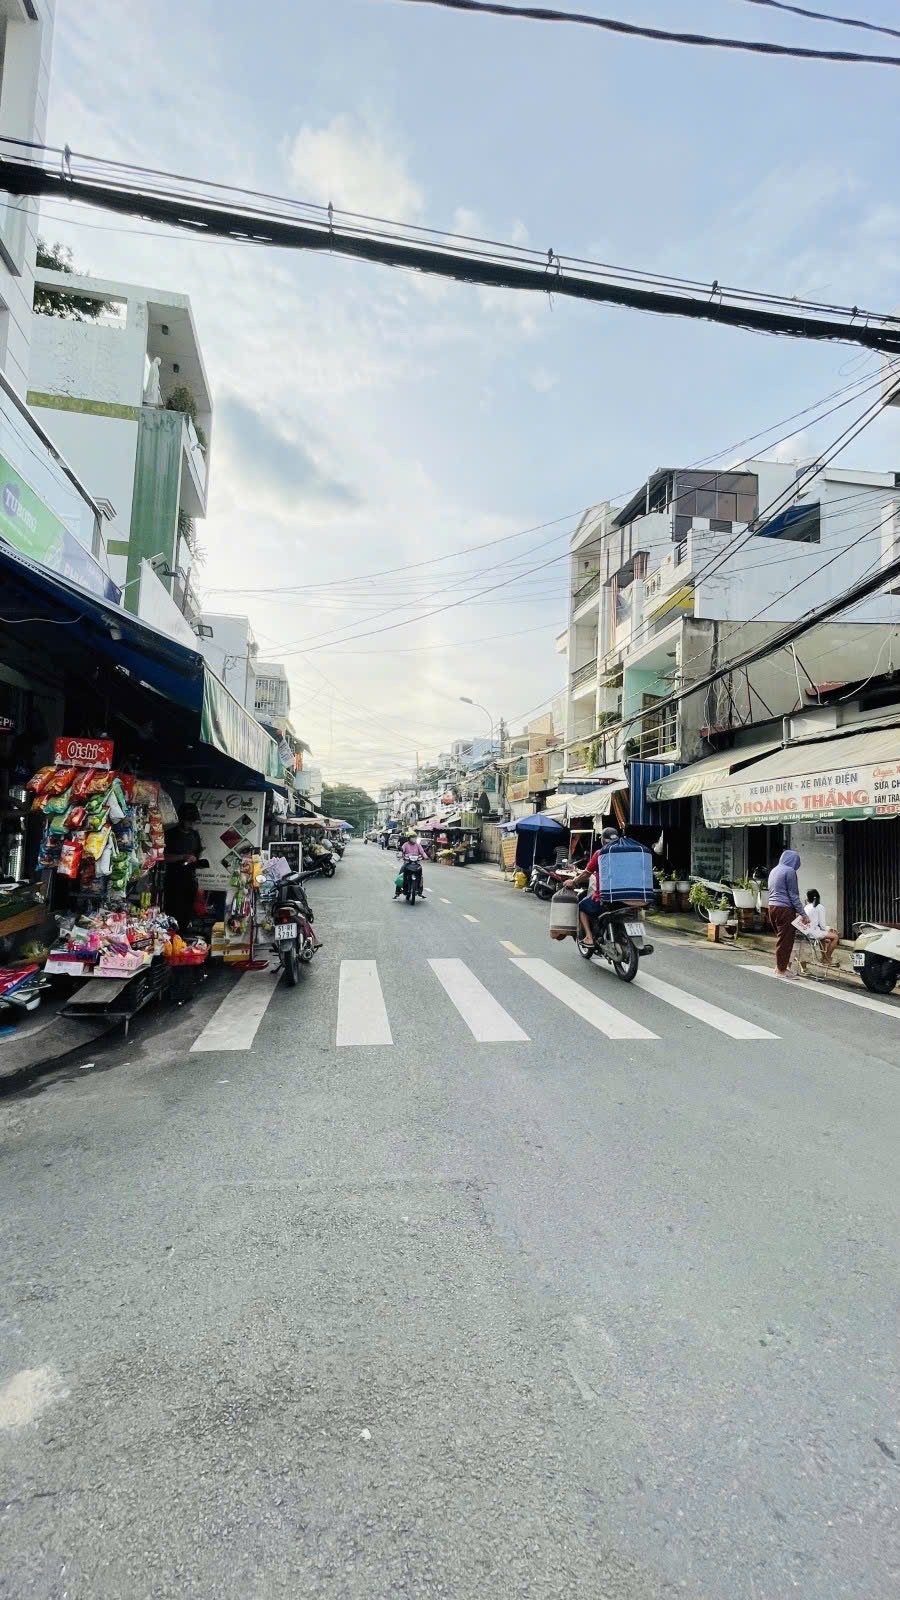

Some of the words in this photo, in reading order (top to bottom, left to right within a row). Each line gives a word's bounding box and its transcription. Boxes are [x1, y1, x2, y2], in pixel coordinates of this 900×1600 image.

[67, 741, 98, 760] Oishi
[750, 787, 758, 795] XE
[801, 779, 811, 789] XE
[814, 775, 833, 788] MÁY
[835, 771, 858, 786] ĐIỆN
[874, 779, 889, 790] SỬA
[874, 794, 886, 804] TÂN
